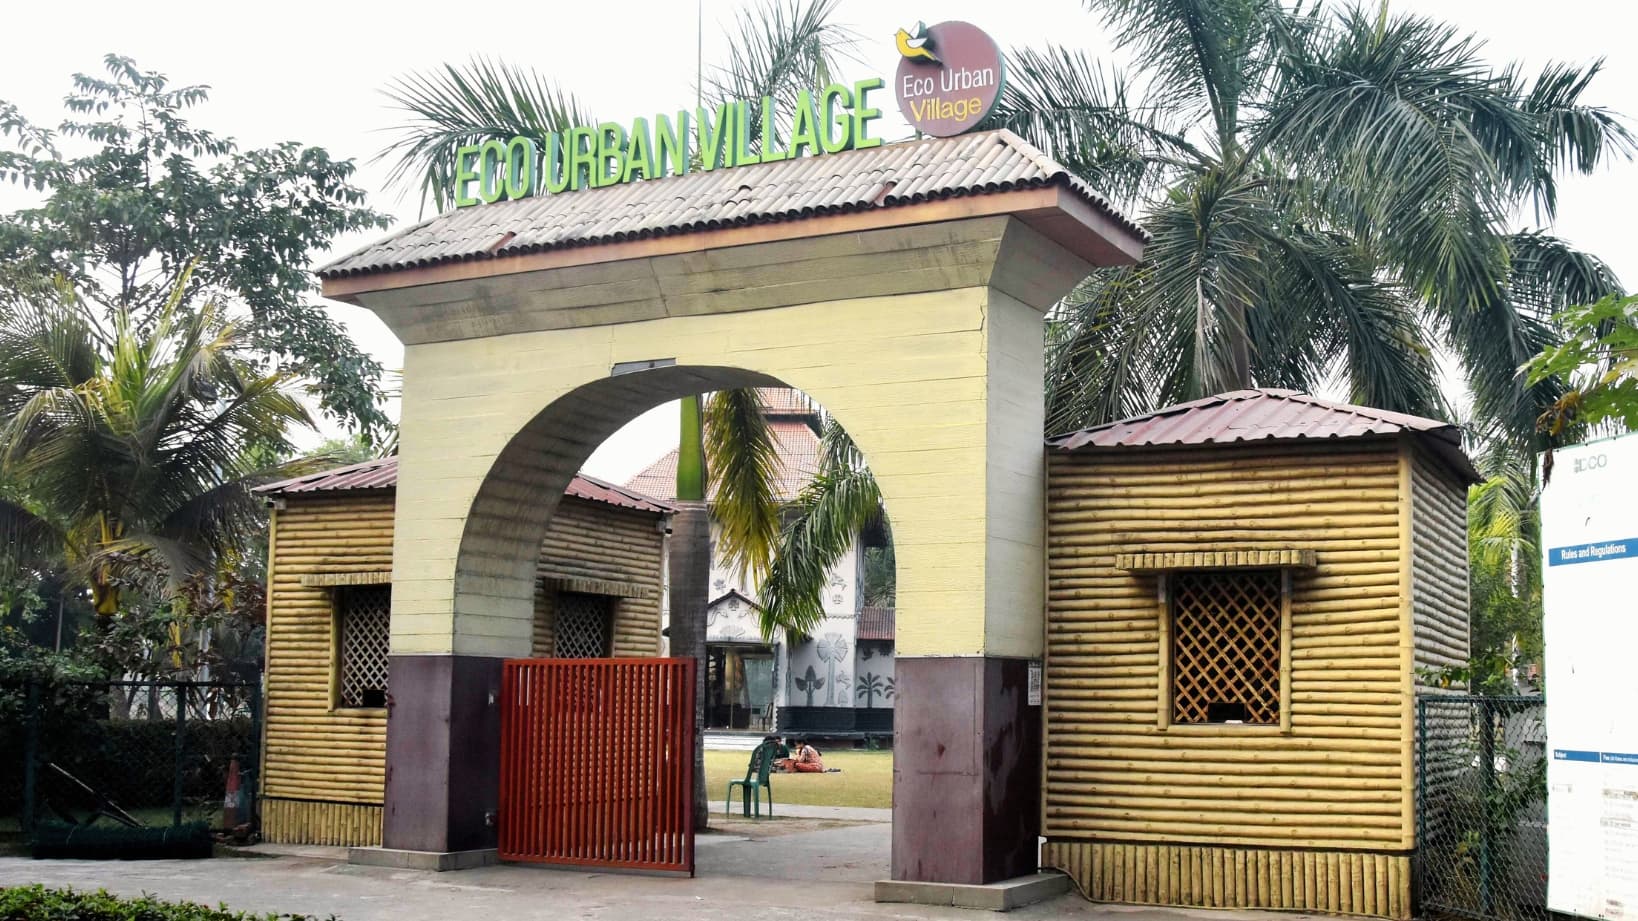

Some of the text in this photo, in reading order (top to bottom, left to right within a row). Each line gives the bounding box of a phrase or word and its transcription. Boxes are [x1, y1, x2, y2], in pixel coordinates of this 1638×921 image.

[903, 67, 994, 98] Eco Urban
[909, 97, 982, 122] Village
[456, 77, 884, 208] ECO URBAN VILLAGE
[1561, 544, 1626, 561] Rules and Regulations
